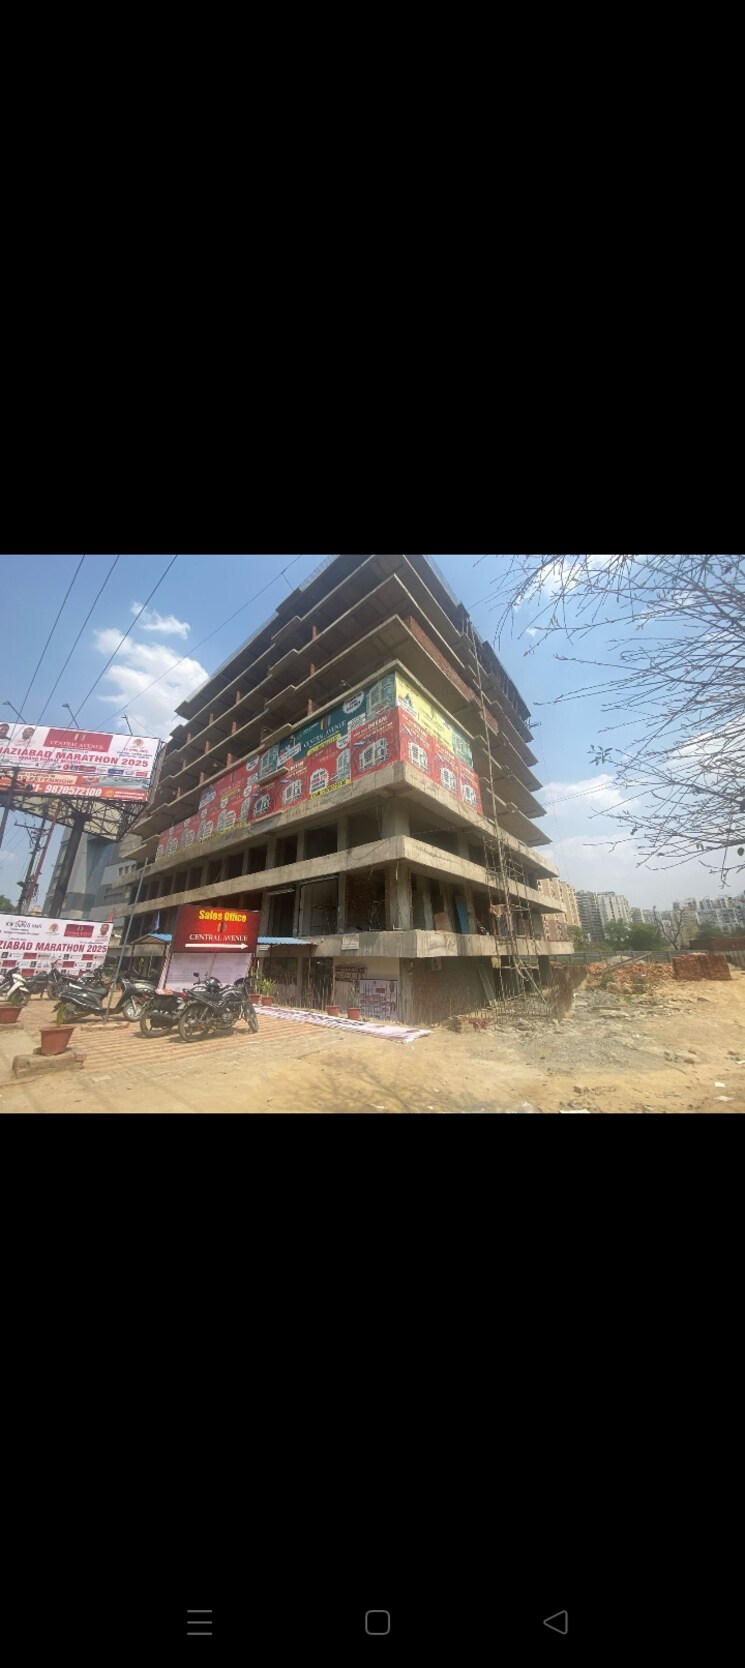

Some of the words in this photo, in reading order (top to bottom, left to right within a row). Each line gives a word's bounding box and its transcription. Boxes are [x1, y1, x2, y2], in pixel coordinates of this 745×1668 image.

[56, 751, 118, 765] MARATHON
[121, 757, 148, 768] 2025
[45, 784, 102, 797] 9870572100
[198, 909, 222, 921] Sales
[224, 912, 247, 923] Office
[189, 933, 221, 941] CENTRAL
[35, 942, 85, 953] MARATHON
[87, 944, 107, 953] 2025
